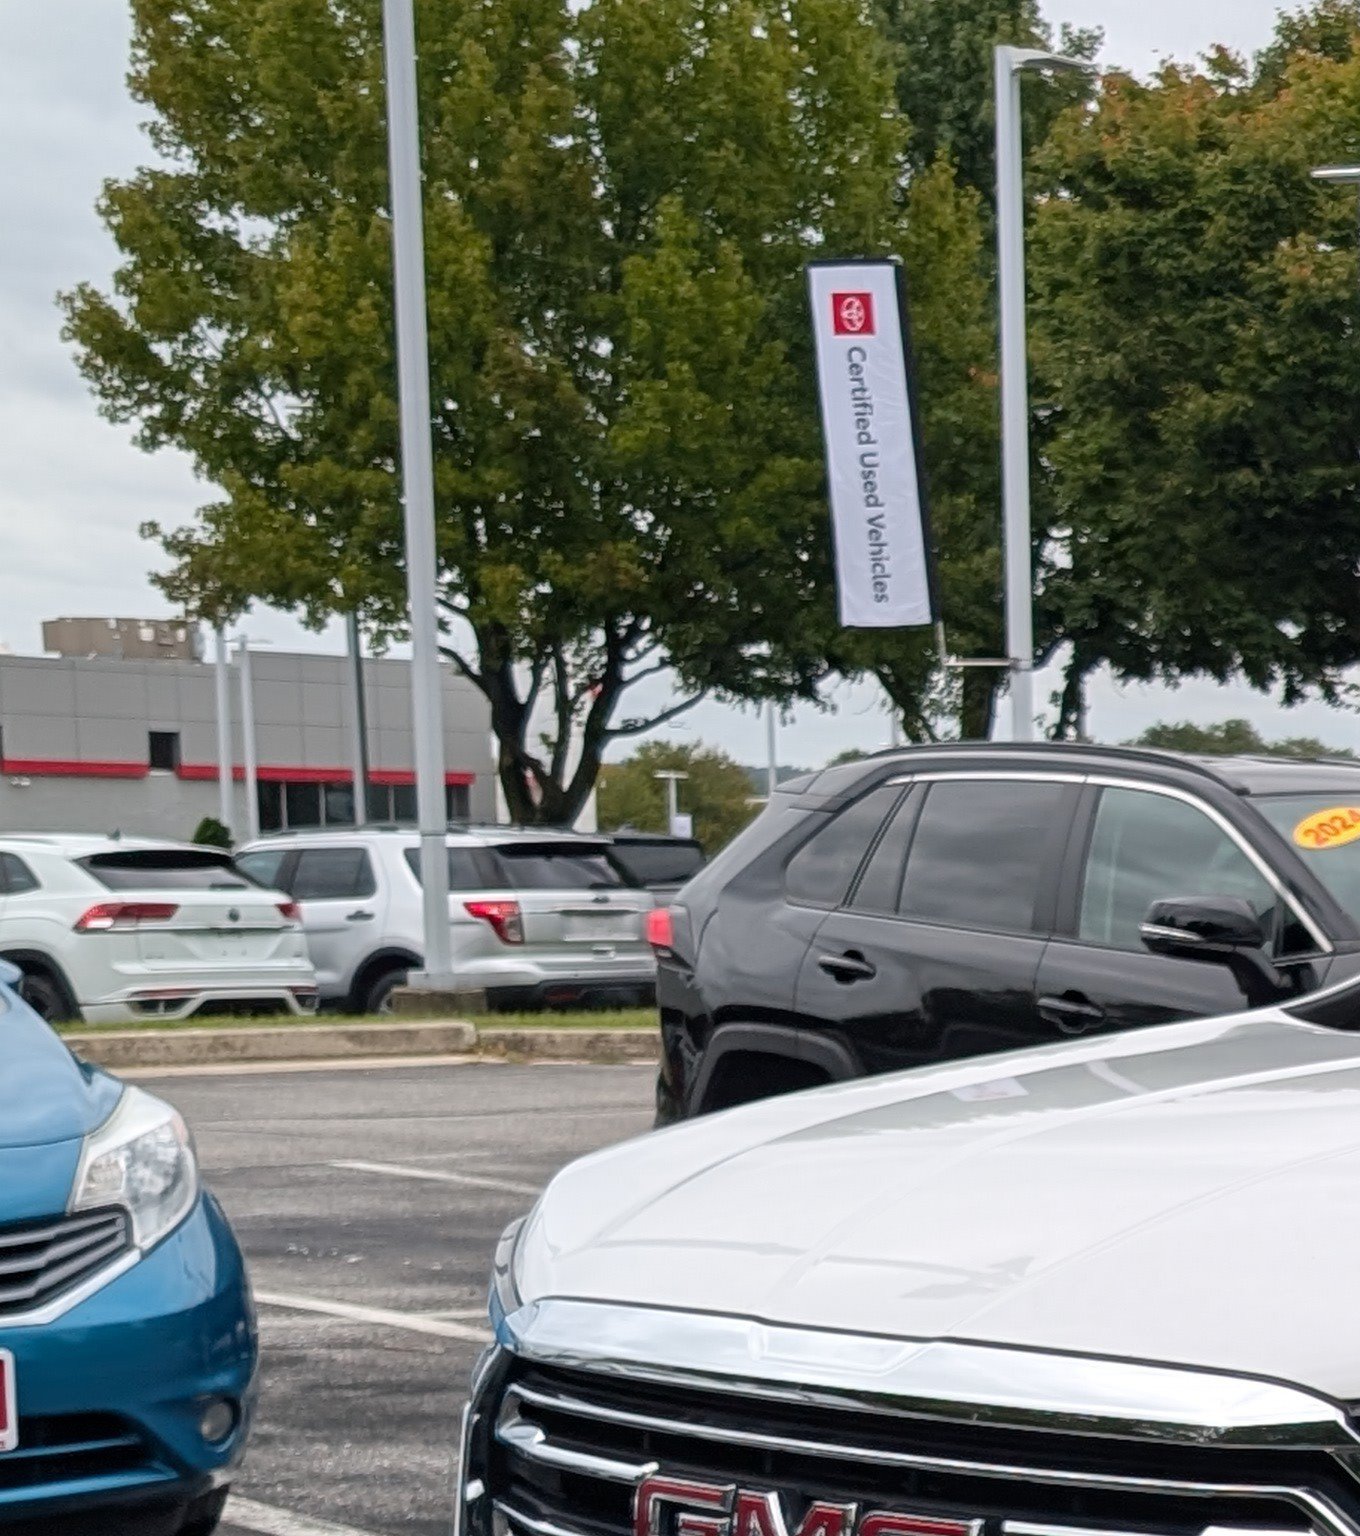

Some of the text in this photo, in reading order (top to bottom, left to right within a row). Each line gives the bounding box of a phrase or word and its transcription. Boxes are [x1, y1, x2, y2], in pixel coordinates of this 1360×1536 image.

[846, 346, 891, 603] Certified Used Vehicles
